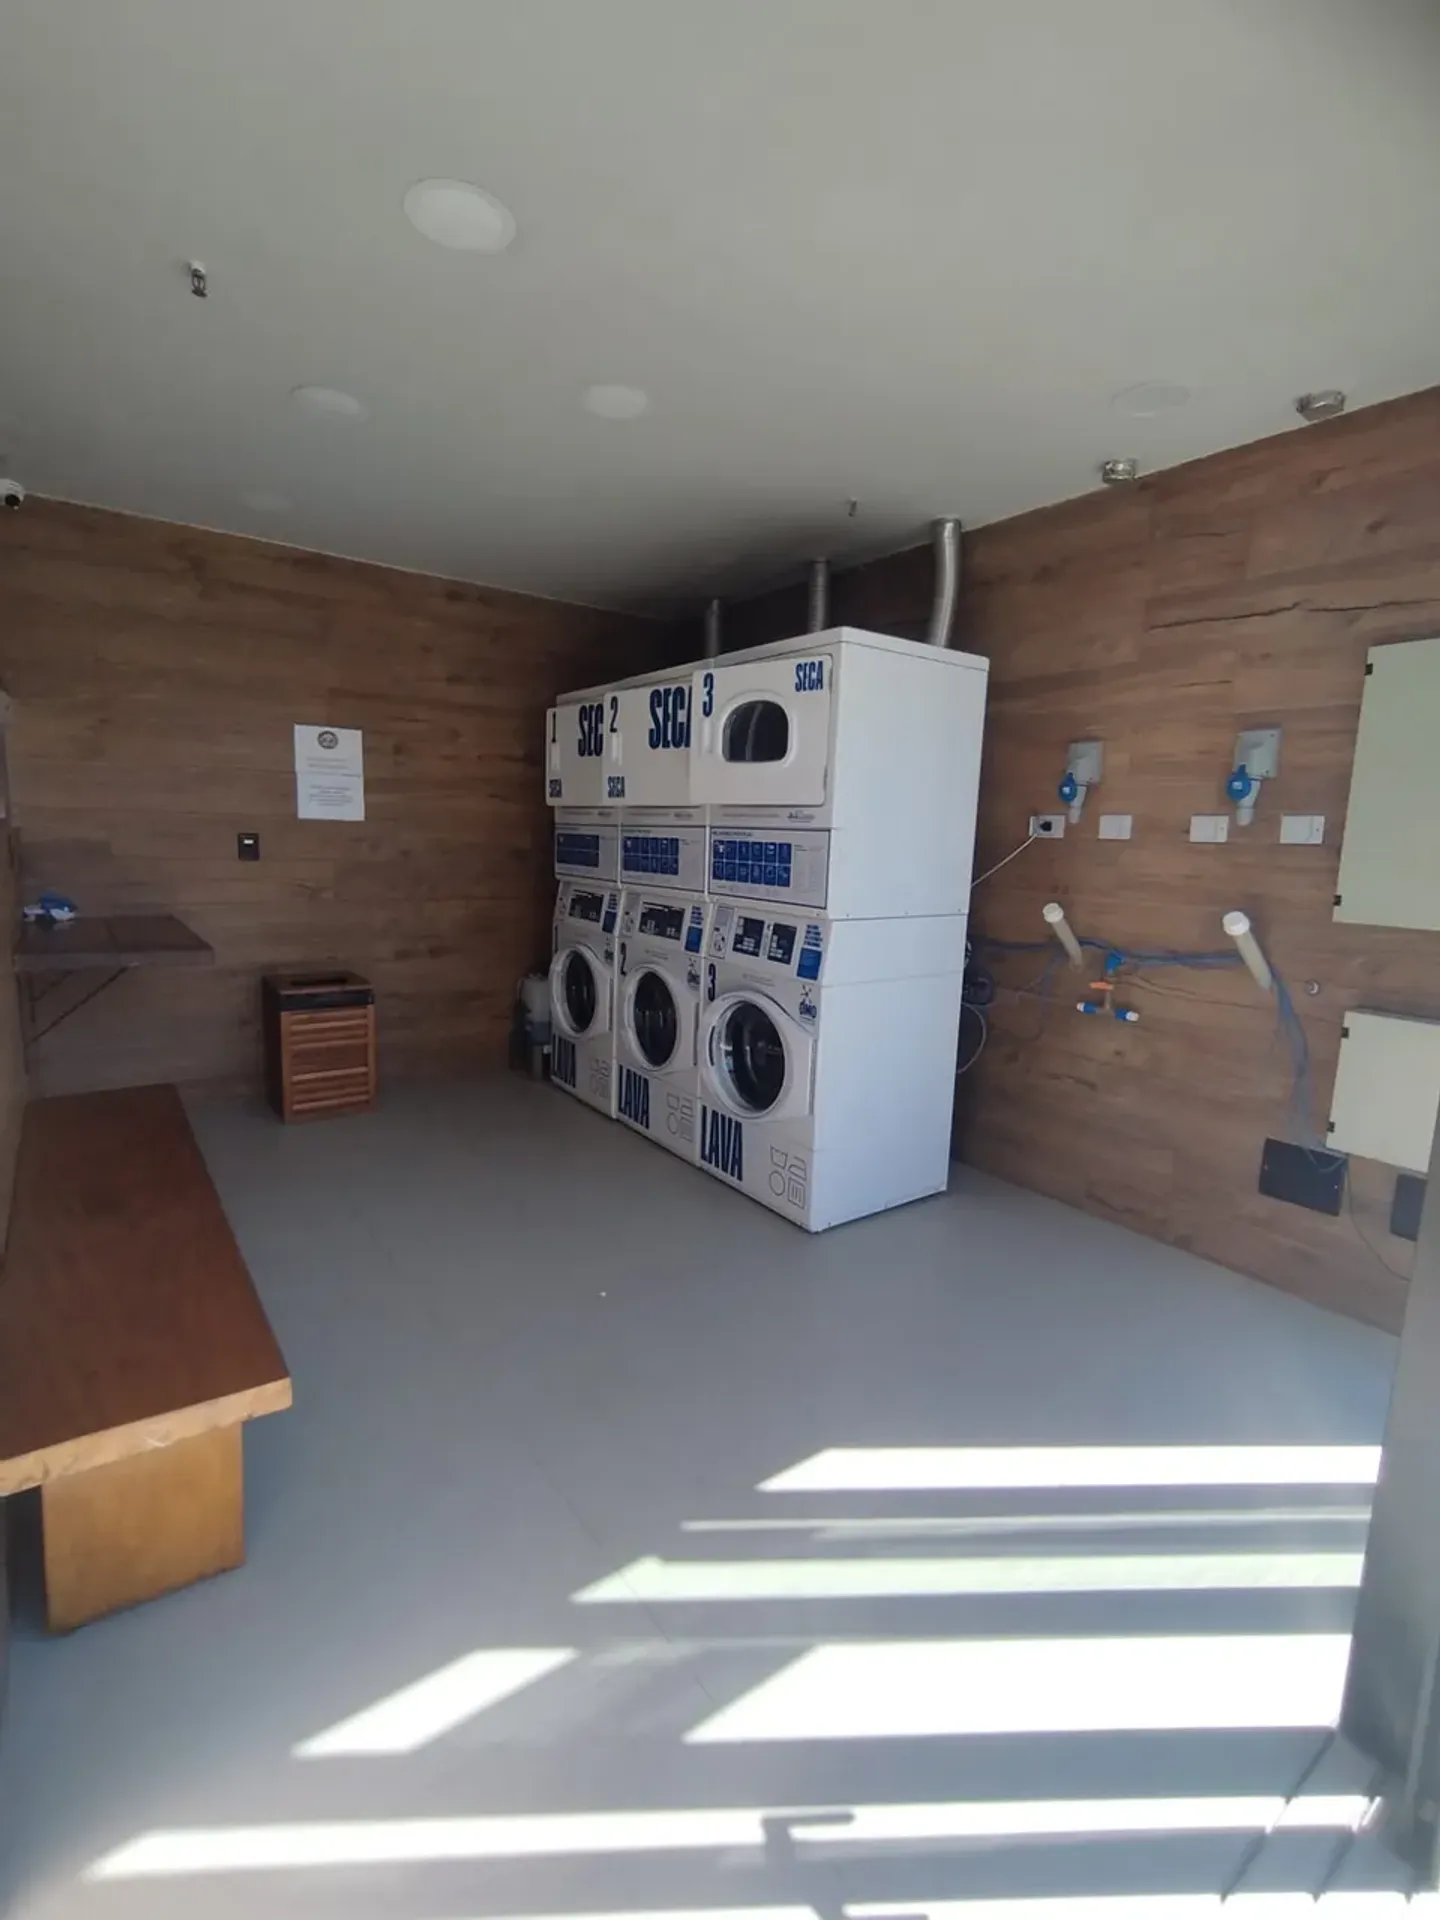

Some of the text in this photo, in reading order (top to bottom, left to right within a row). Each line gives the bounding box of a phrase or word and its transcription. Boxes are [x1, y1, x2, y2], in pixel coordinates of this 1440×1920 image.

[703, 672, 714, 718] 3
[795, 660, 824, 692] SECA
[551, 711, 557, 743] 1
[578, 703, 604, 757] SEC
[610, 696, 618, 733] 2
[620, 942, 628, 977] 2
[707, 962, 717, 1003] 3
[618, 1063, 650, 1131] LAVA
[700, 1104, 744, 1182] LAVA
